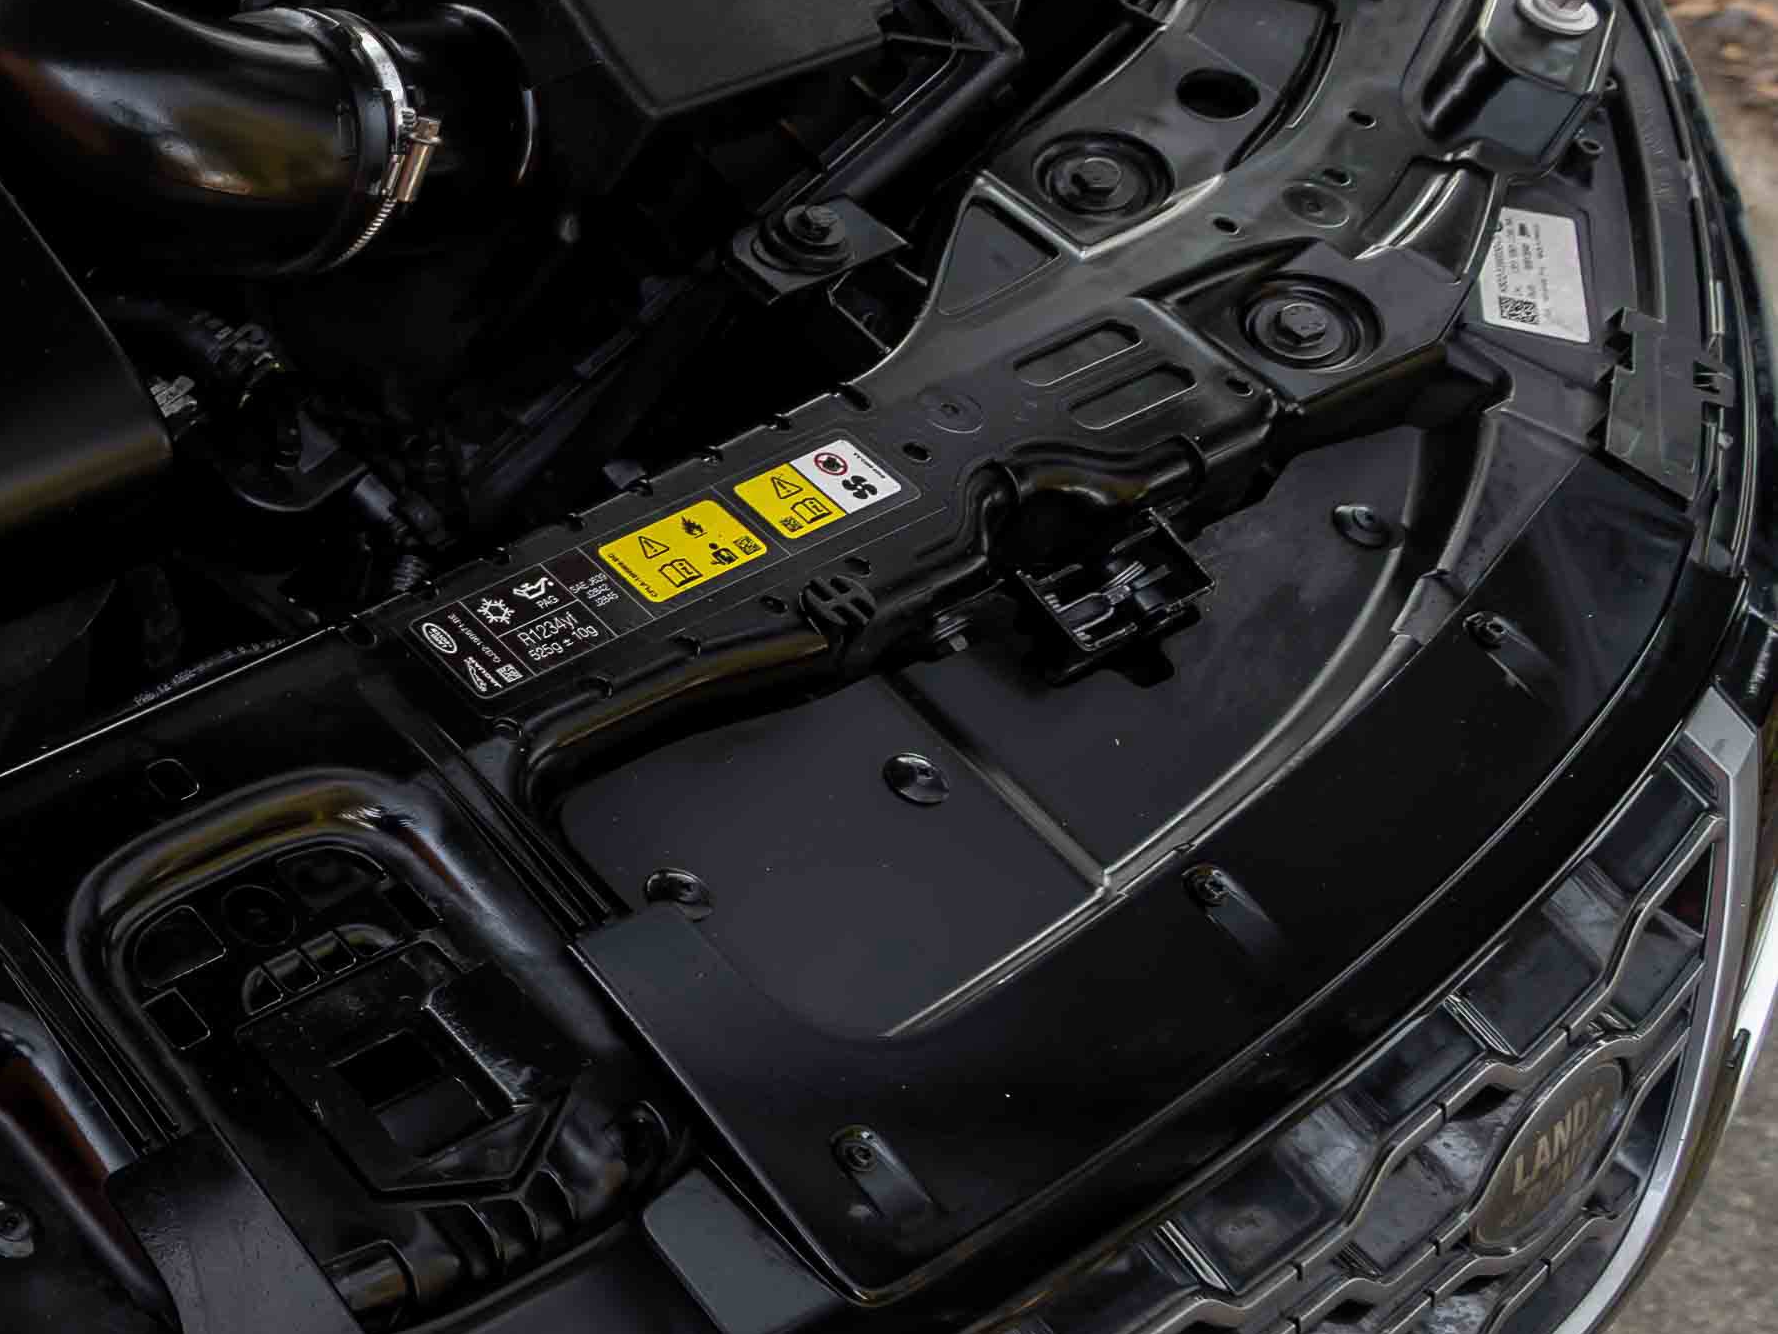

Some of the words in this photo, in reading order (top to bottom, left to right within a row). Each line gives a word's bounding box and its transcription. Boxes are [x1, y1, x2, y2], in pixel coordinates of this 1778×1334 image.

[535, 595, 560, 610] PAG
[517, 611, 579, 647] R1234yf
[528, 641, 564, 661] 525g
[572, 625, 598, 642] 10g
[1512, 1095, 1590, 1195] LAND
